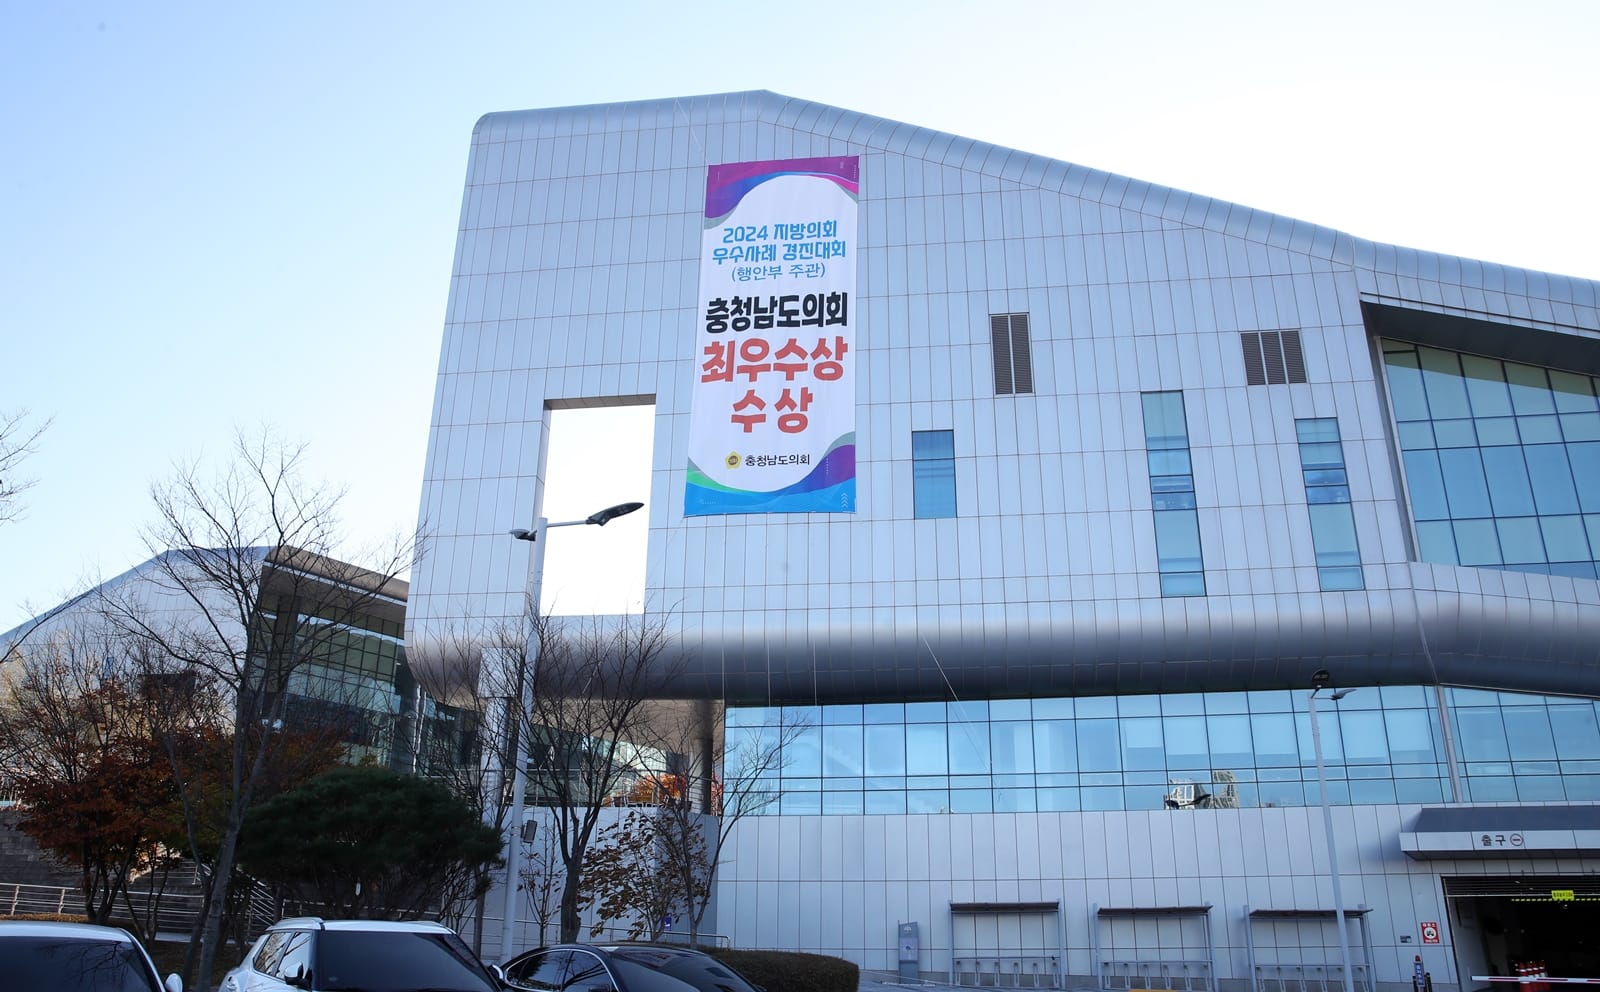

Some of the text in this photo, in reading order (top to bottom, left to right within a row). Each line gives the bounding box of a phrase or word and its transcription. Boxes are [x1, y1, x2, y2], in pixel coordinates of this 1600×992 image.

[723, 220, 837, 243] 2024 지방의회
[712, 240, 846, 265] 우수사례 경진대회
[731, 263, 826, 281] (행안부 주관)
[705, 291, 848, 334] 충청남도의회
[701, 336, 848, 383] 최우수상
[745, 454, 810, 467] 충청남도의회
[1481, 834, 1506, 846] 출구
